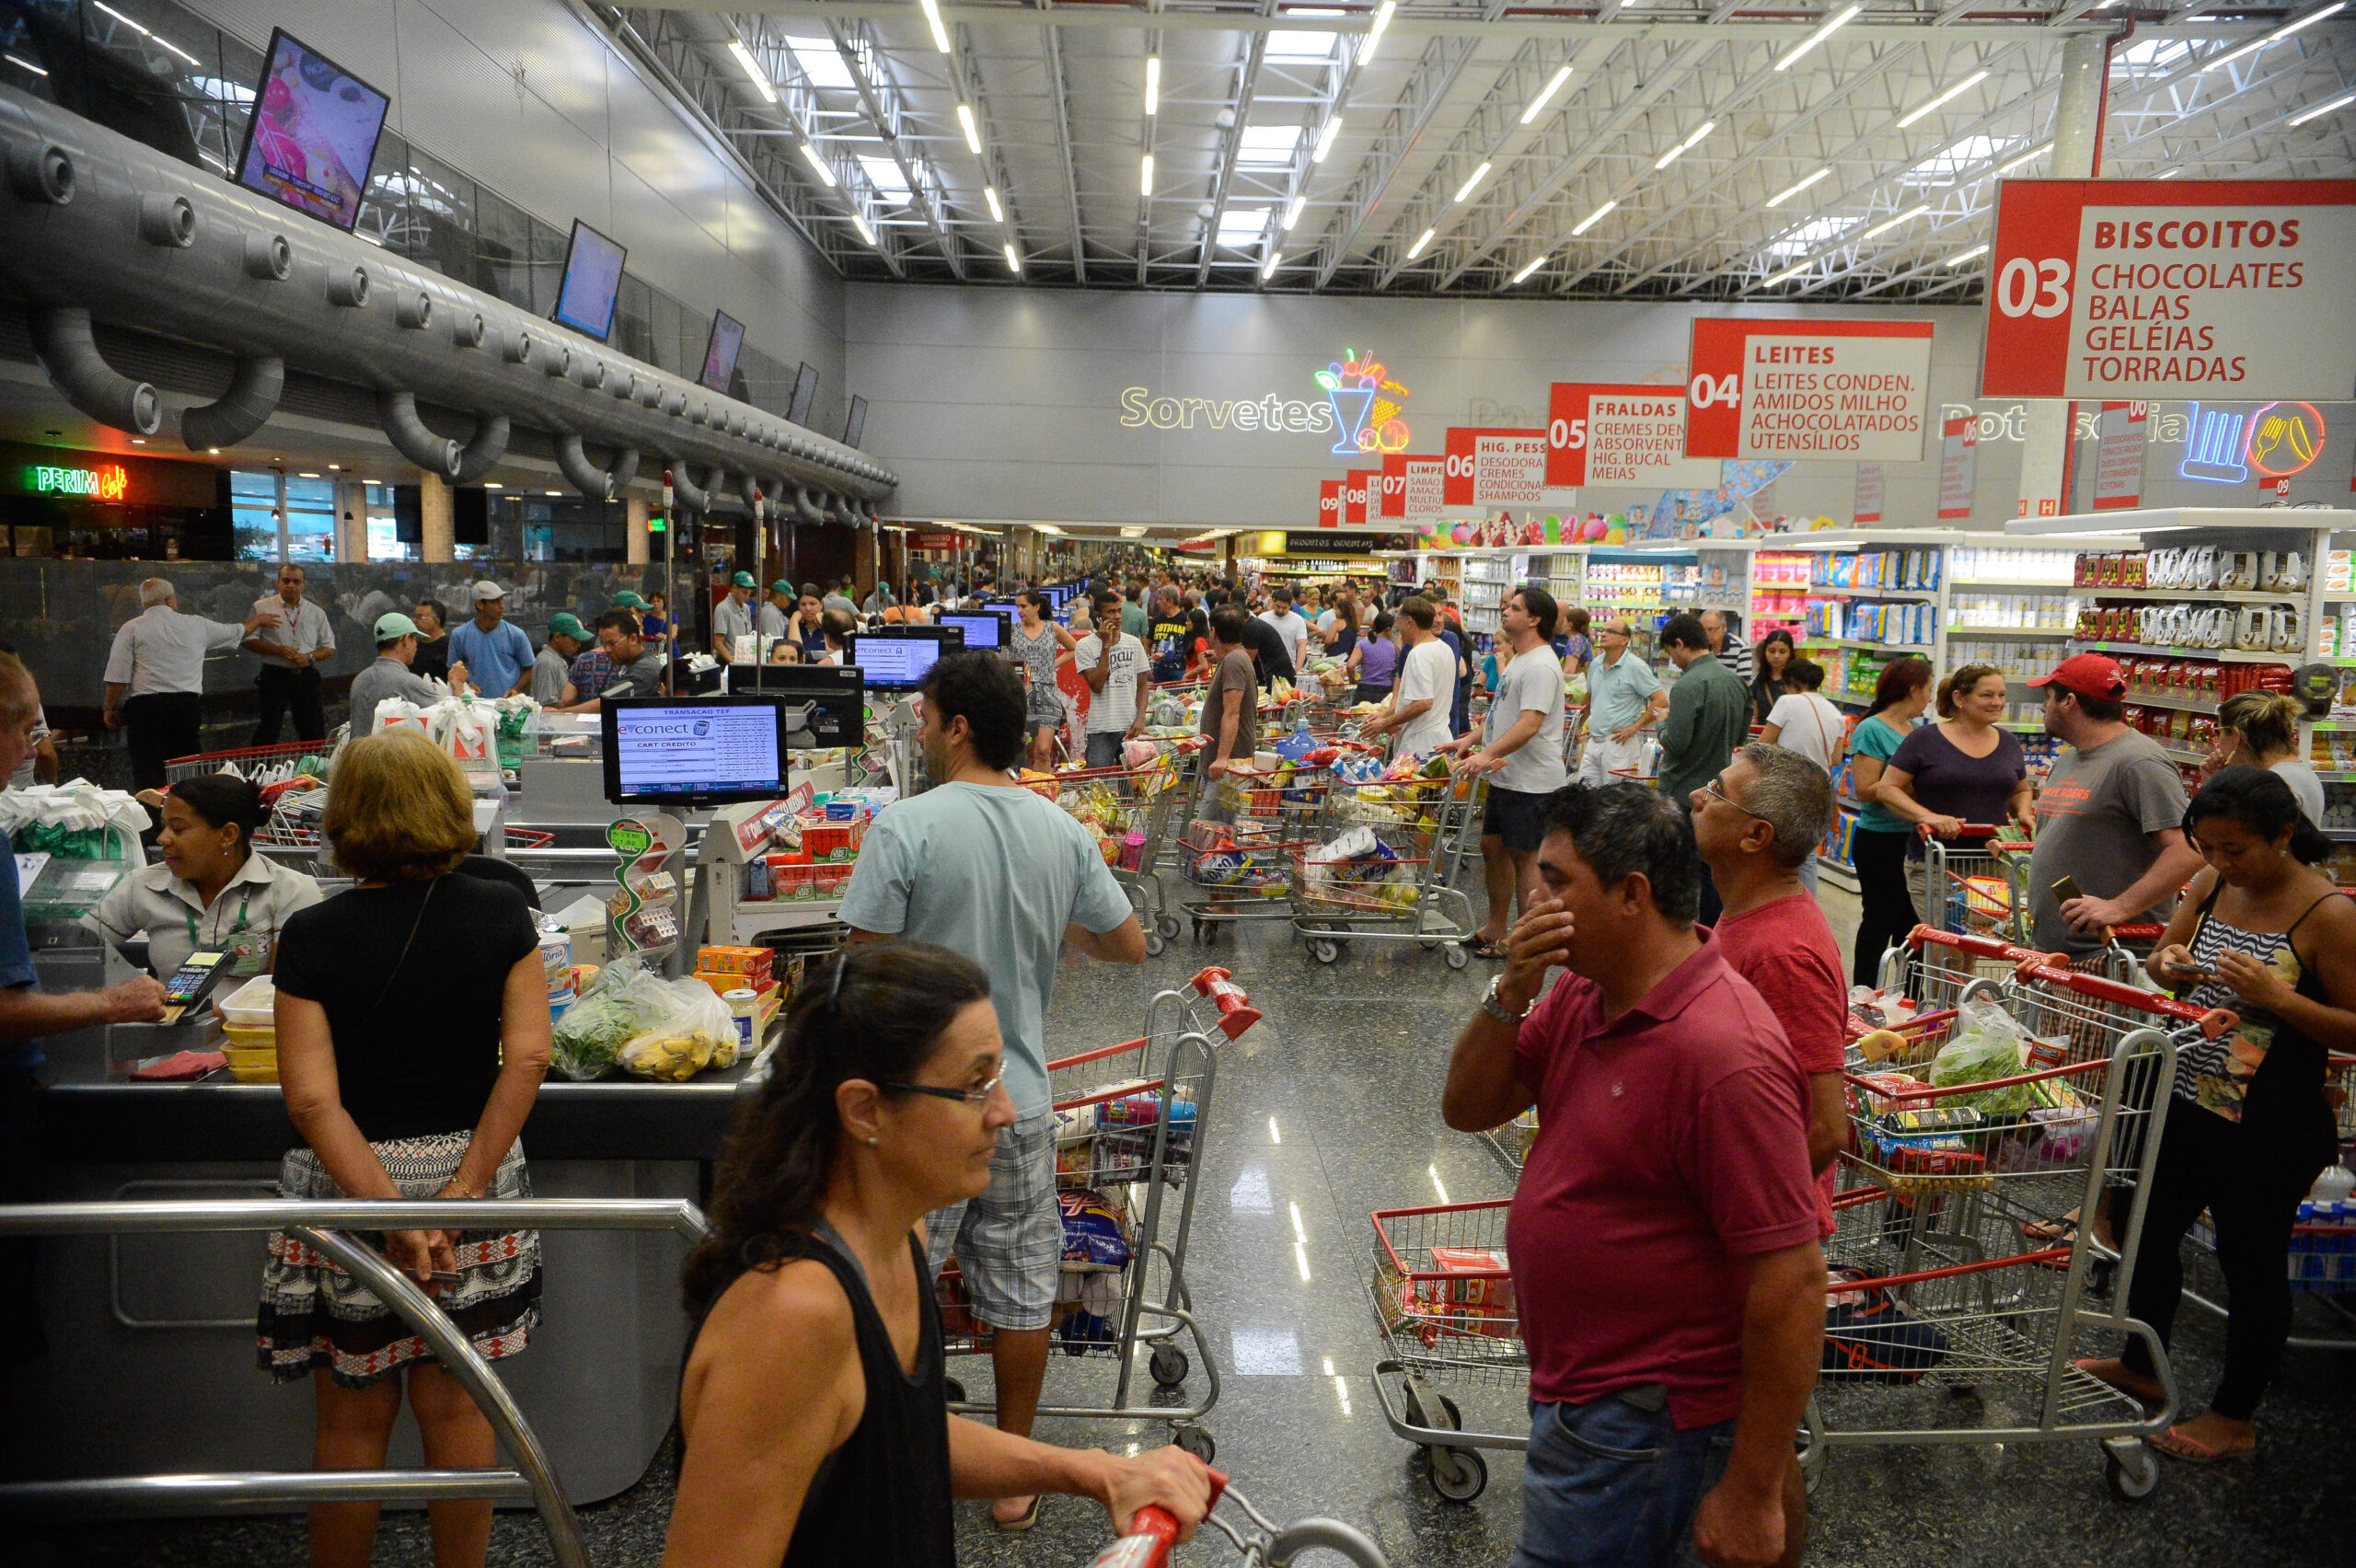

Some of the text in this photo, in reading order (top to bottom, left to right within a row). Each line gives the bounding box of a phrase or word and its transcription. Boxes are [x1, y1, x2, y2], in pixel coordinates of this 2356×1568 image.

[2094, 220, 2300, 248] BISCOITOS
[2091, 262, 2304, 289] CHOCOLATES
[1997, 257, 2071, 318] 03
[2088, 294, 2190, 320] BALAS
[2085, 319, 2214, 352] GELÉIAS
[1755, 346, 1834, 364] LEITES
[2083, 356, 2246, 382] TORRADAS
[1691, 374, 1739, 409] 04
[1754, 374, 1915, 391] LEITES CONDEN.
[1120, 386, 1333, 433] Sorvetes
[1596, 403, 1677, 417] FRALDAS
[1752, 393, 1907, 411] AMIDOS MILHO
[1595, 422, 1653, 436] CREMES
[1751, 413, 1919, 432] ACHOCOLATADOS
[1965, 421, 1978, 442] 06
[1550, 419, 1586, 449] 05
[1750, 430, 1861, 451] UTENSÍLIOS
[1481, 443, 1509, 452] HIG.
[1446, 455, 1474, 478] 06
[1593, 453, 1671, 466] HIG. BUCAL
[37, 467, 98, 494] PERIM
[1480, 468, 1525, 478] CREMES
[1592, 467, 1635, 479] MEIAS
[1383, 476, 1405, 494] 07
[2277, 479, 2289, 493] 09
[1321, 498, 1338, 510] 09
[1347, 490, 1367, 503] 08
[1410, 496, 1443, 504] MULTIU
[1479, 490, 1541, 501] SHAMPOOS
[1409, 504, 1442, 513] CLOROS
[2042, 501, 2053, 514] H
[543, 949, 562, 963] lória
